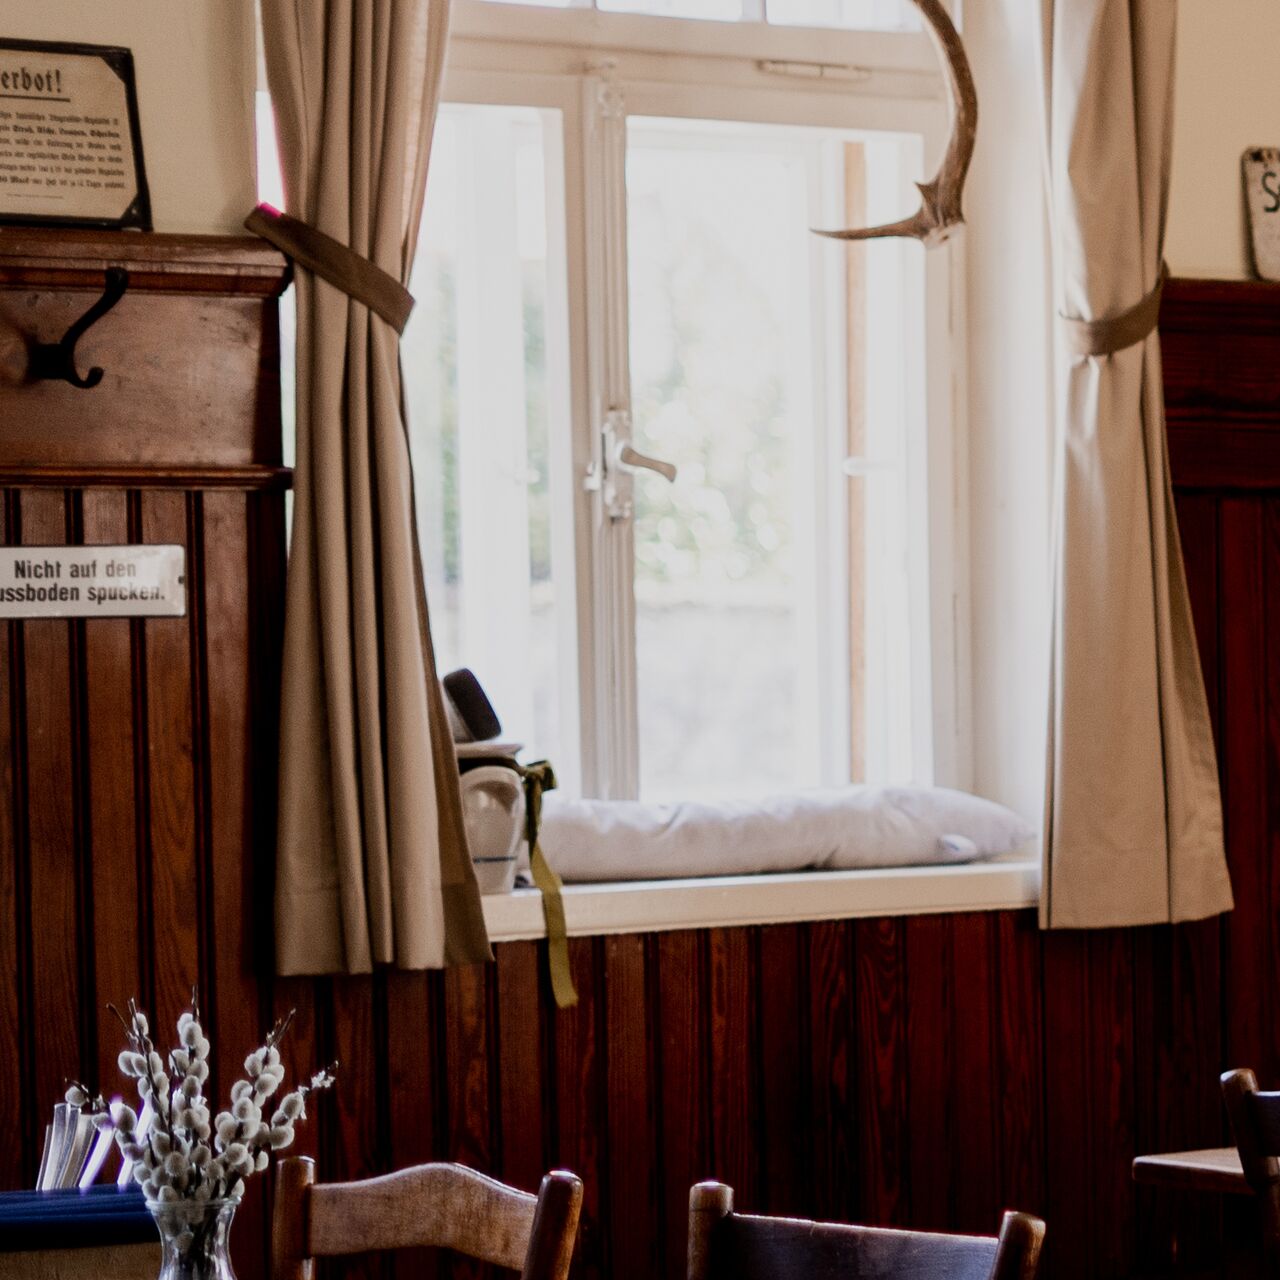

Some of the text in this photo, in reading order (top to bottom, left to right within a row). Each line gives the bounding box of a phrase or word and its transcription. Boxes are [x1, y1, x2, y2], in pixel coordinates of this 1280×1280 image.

[15, 560, 137, 579] Nicht auf den
[87, 583, 165, 605] spucken.
